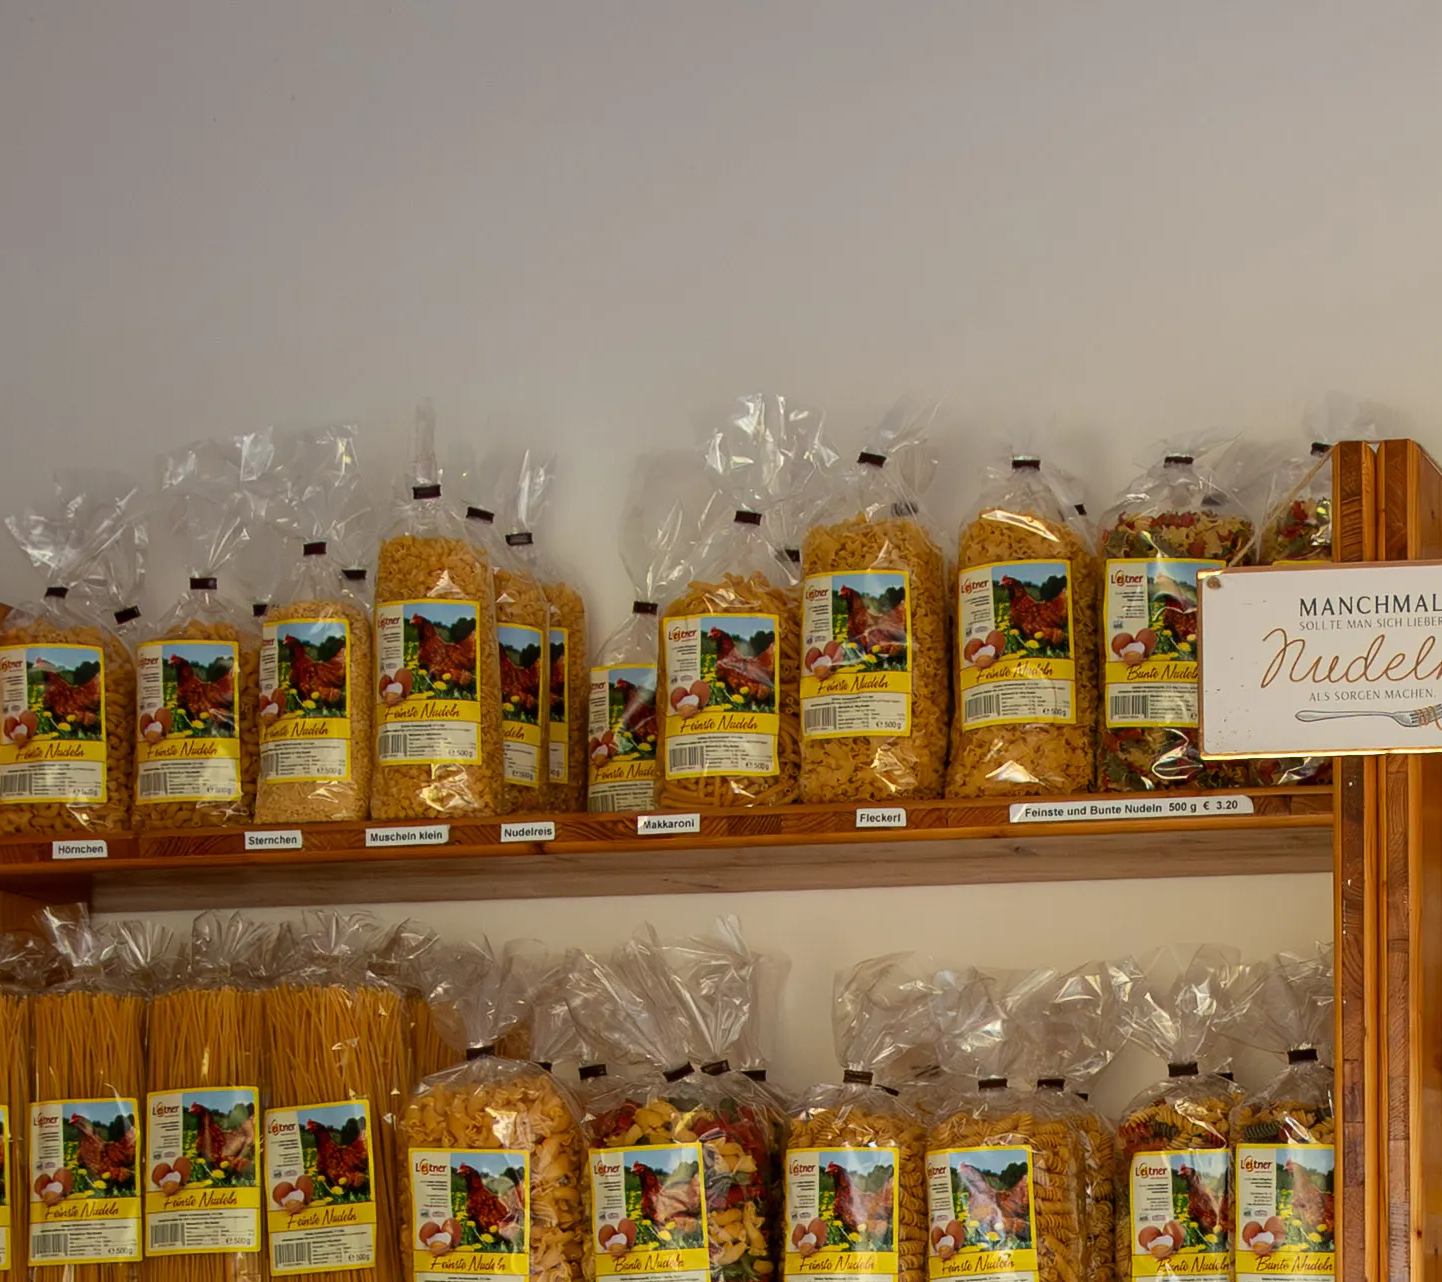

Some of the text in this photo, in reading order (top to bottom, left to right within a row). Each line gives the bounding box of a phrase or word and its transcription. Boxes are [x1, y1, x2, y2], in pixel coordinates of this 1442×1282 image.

[1299, 618, 1342, 632] SOLLTE
[1346, 618, 1374, 630] MAN
[1377, 617, 1404, 629] SICH
[1309, 691, 1331, 703] ALS
[1334, 689, 1382, 702] SORGEN
[1024, 807, 1065, 818] Feinste
[1066, 805, 1087, 817] und
[1089, 804, 1122, 816] Bunte
[1124, 803, 1163, 814] Nudeln
[1168, 801, 1188, 813] 500
[1215, 799, 1239, 811] 3.20
[369, 830, 444, 843] Muscheln klein
[503, 826, 553, 838] Nudelreis
[247, 834, 298, 846] Sternchen
[57, 844, 105, 855] Hörnchen
[198, 1191, 238, 1208] Nudeln
